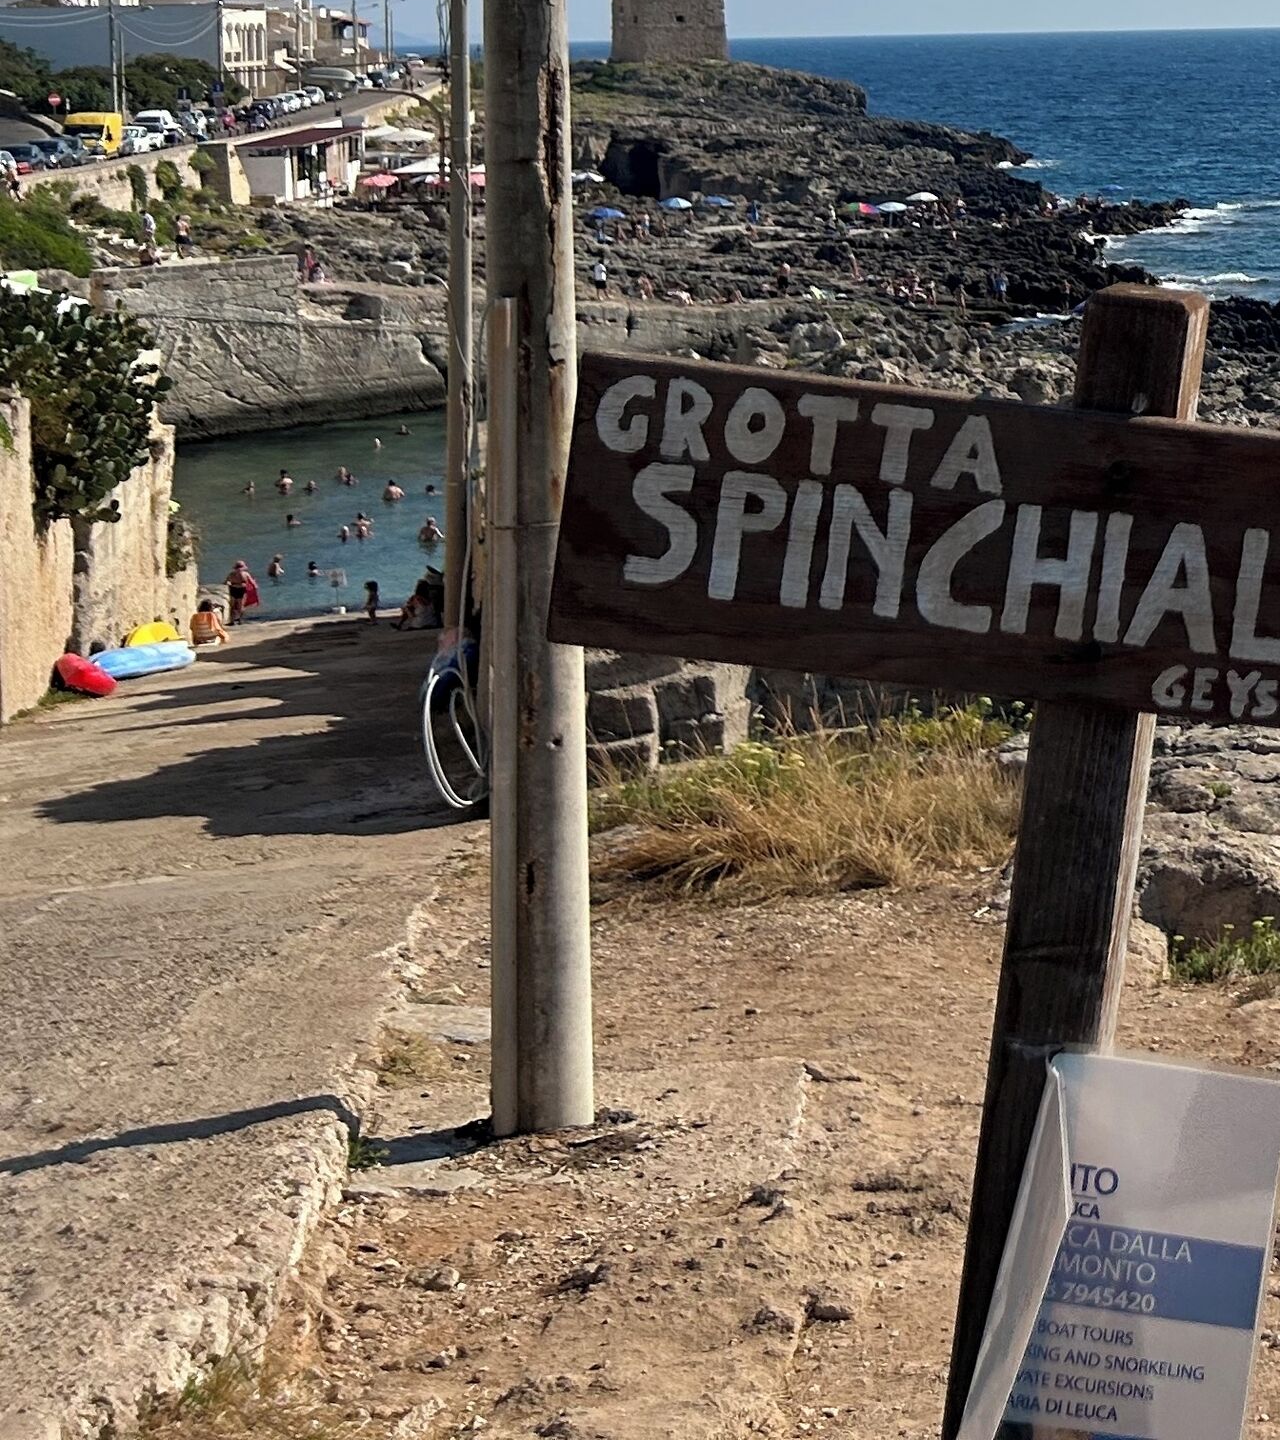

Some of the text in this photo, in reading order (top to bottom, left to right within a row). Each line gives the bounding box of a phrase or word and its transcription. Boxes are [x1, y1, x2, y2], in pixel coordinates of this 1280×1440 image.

[595, 375, 1004, 495] GROTTA
[1110, 1230, 1192, 1263] DALLA
[1062, 1281, 1155, 1312] 7945420
[1037, 1318, 1135, 1346] BOAT TOURS
[1064, 1349, 1101, 1367] AND
[1104, 1355, 1206, 1381] SNORKELING
[1054, 1373, 1155, 1401] EXCURSIONS
[1046, 1398, 1064, 1415] DI
[1065, 1400, 1118, 1422] LEUCA
